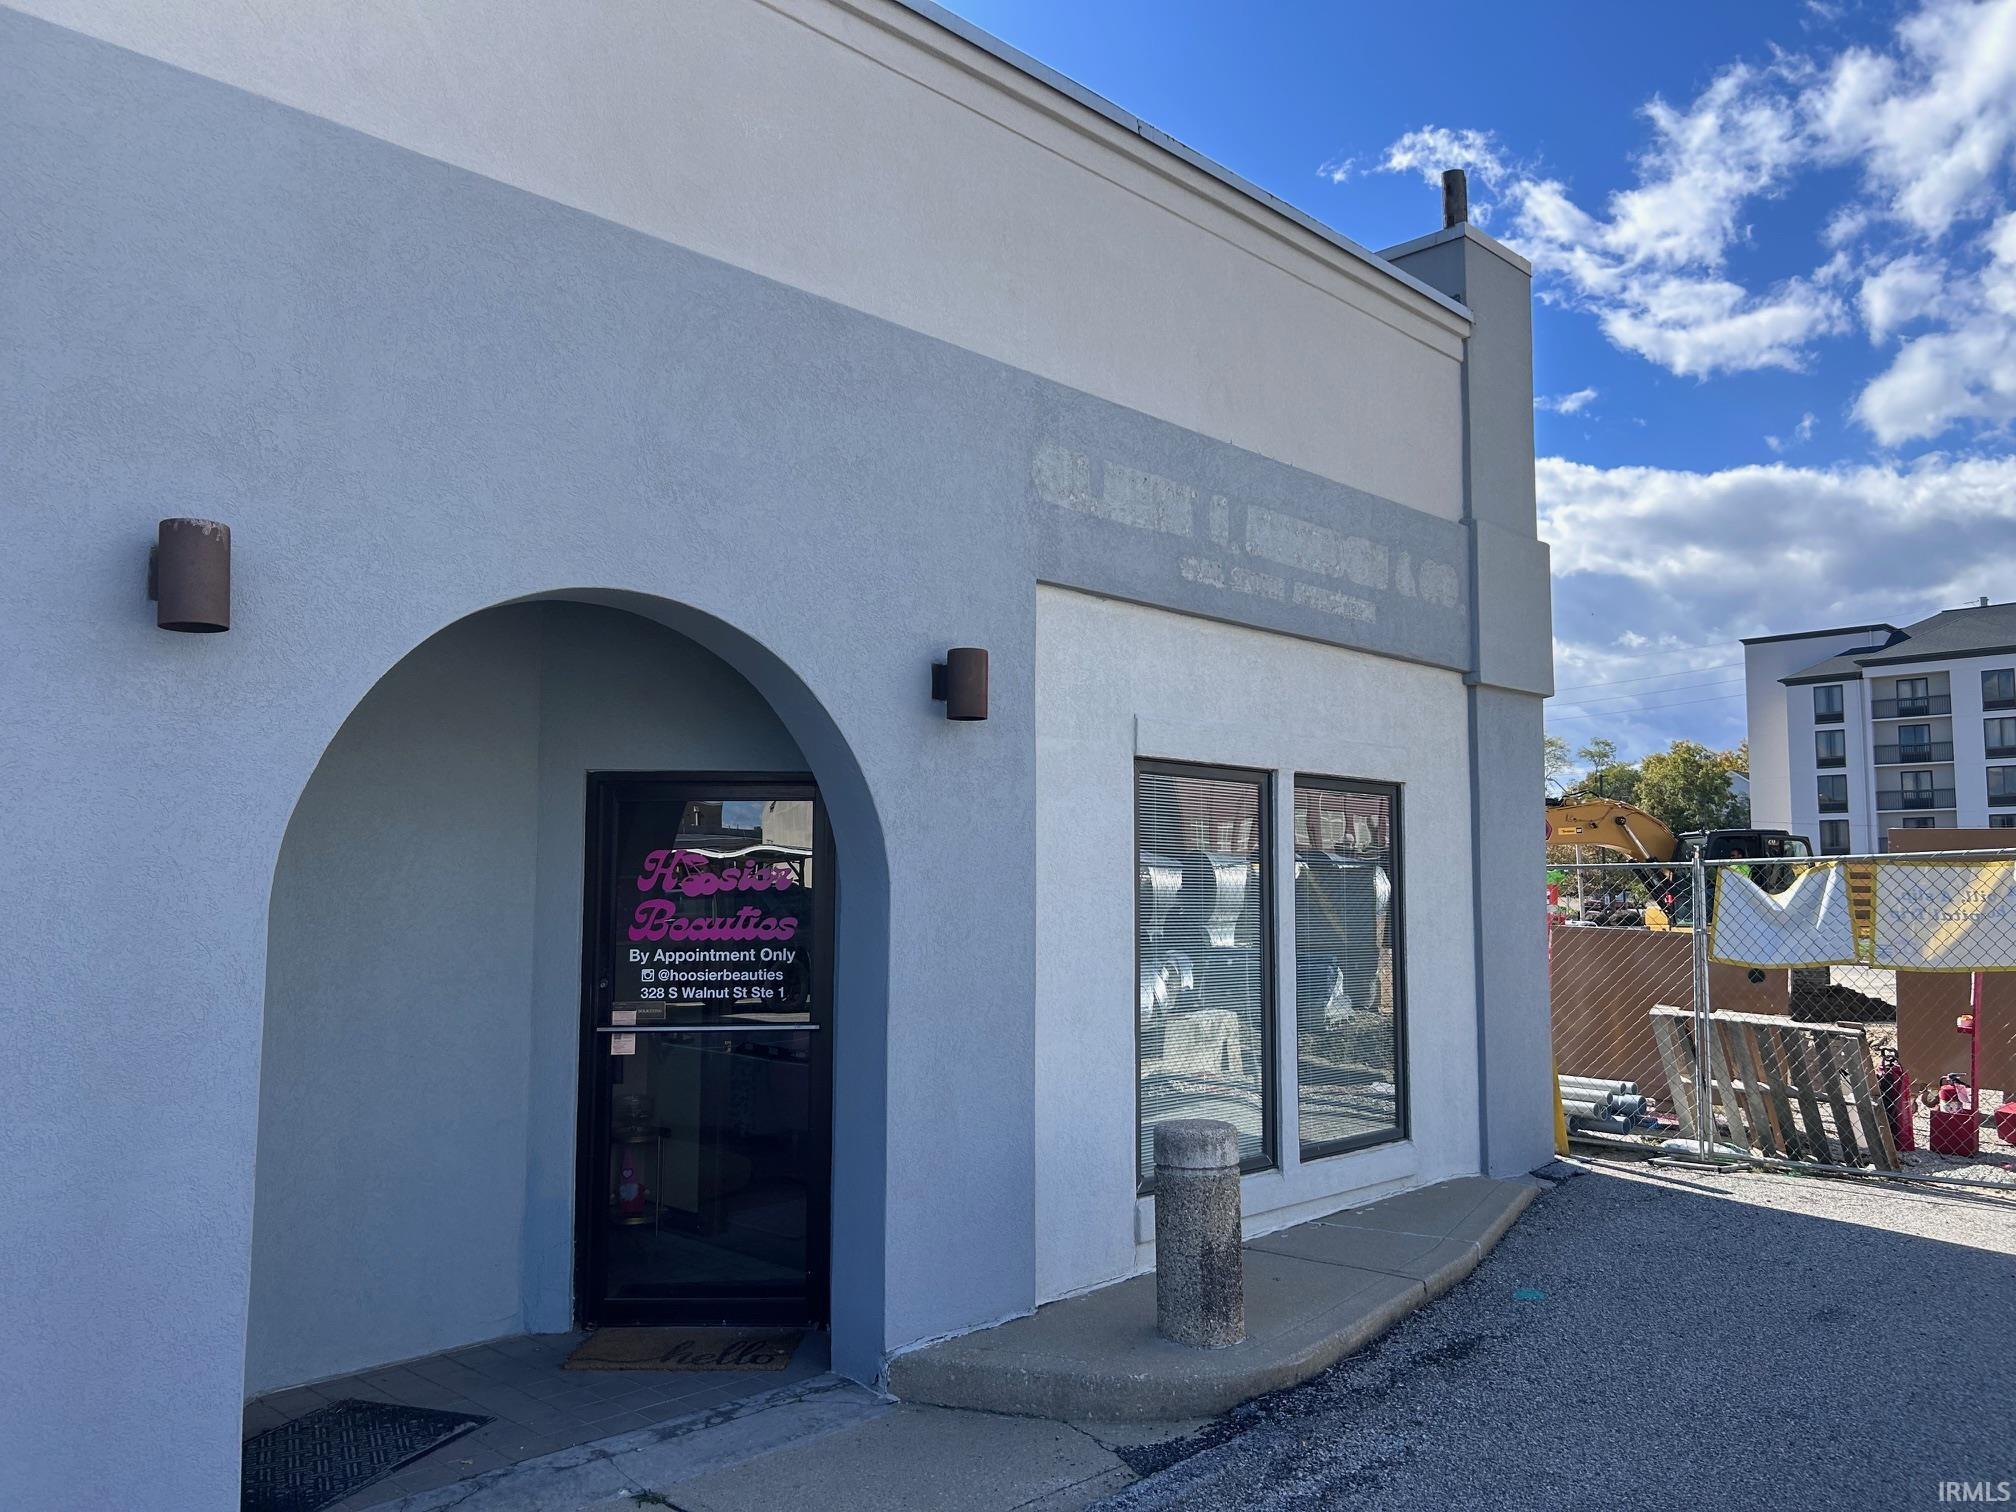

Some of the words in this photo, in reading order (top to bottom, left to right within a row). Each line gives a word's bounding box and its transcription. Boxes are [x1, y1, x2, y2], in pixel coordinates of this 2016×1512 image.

[637, 849, 793, 897] Hoosier
[628, 898, 799, 941] Beauties
[629, 948, 650, 964] By
[653, 948, 756, 964] Appointment
[760, 948, 796, 963] Only
[658, 968, 784, 981] @hoosierbeauties
[640, 987, 665, 999] 328
[668, 987, 678, 999] S
[682, 986, 729, 998] Walnut
[733, 986, 748, 998] St
[751, 986, 774, 998] Ste
[778, 986, 785, 998] 1
[655, 1339, 784, 1366] hello
